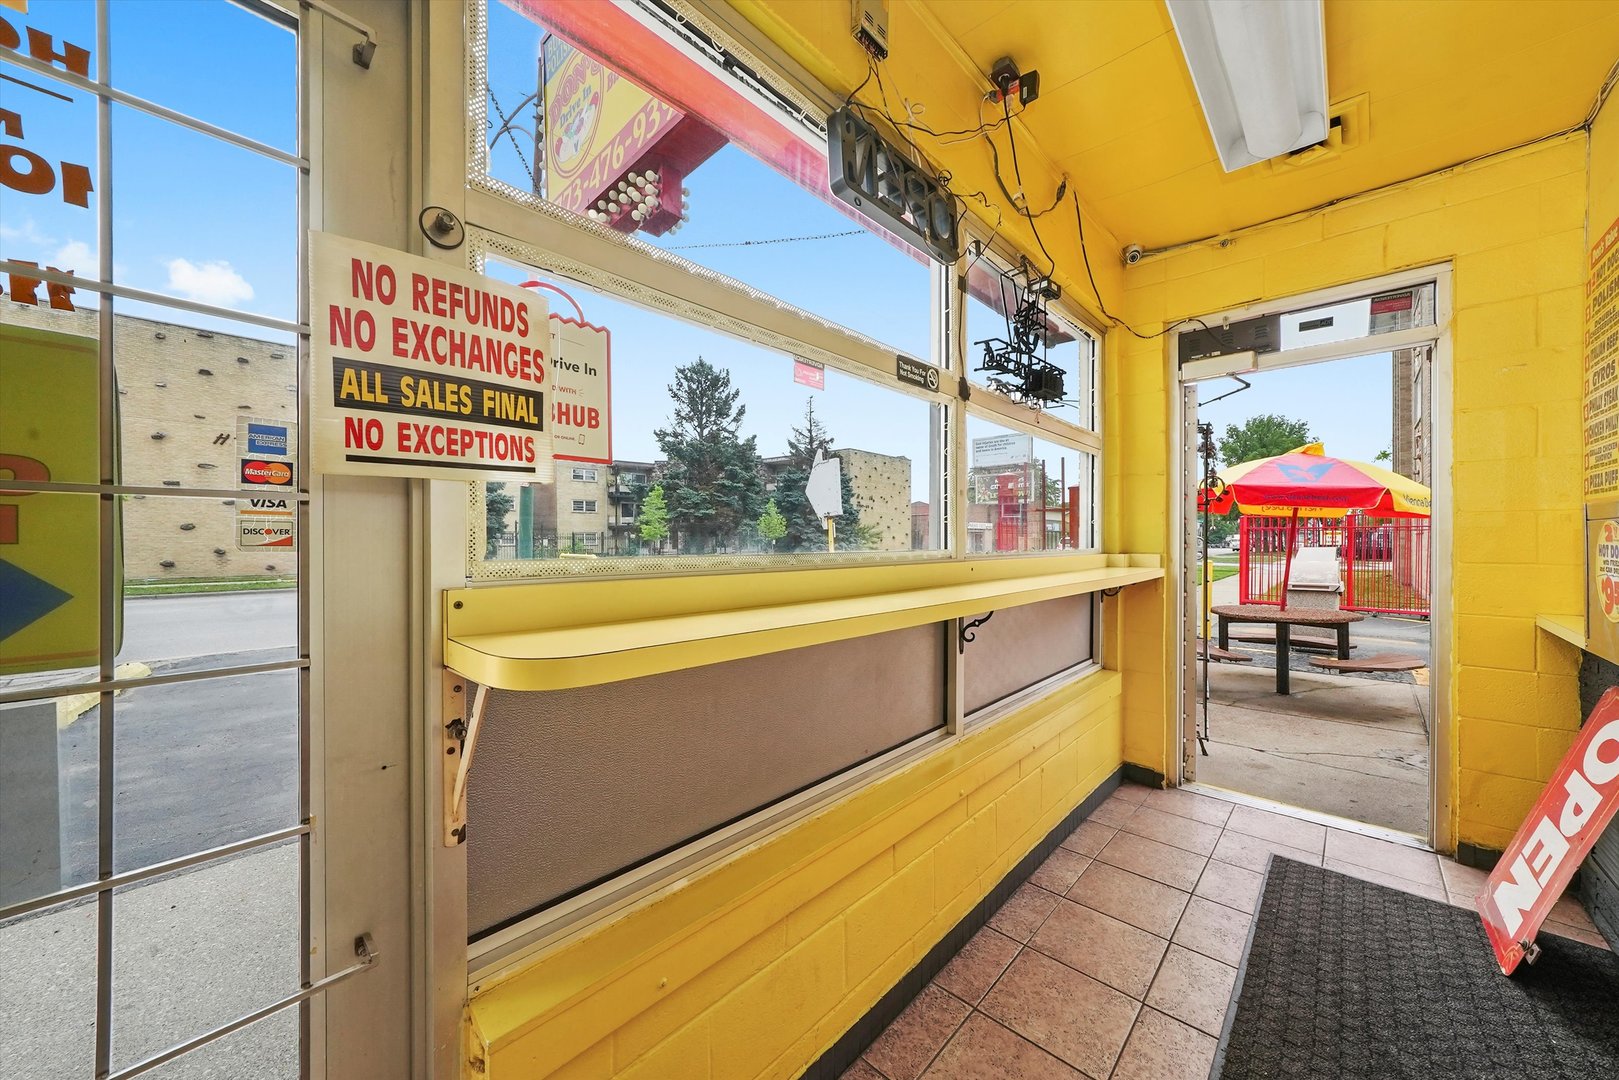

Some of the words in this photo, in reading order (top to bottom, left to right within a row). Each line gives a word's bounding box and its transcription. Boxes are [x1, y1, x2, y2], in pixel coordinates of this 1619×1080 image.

[560, 97, 581, 129] Drive
[352, 258, 396, 305] NO
[412, 273, 529, 338] REFUNDS
[329, 305, 375, 352] NO
[392, 317, 544, 383] EXCHANGES
[551, 358, 579, 373] rive
[585, 363, 597, 377] In
[899, 360, 911, 372] Thank
[1593, 358, 1616, 387] GYROS
[907, 371, 925, 384] Smoking
[340, 368, 388, 404] ALL
[400, 376, 472, 415] SALES
[483, 390, 538, 424] FINAL
[559, 386, 577, 395] WITH
[1603, 384, 1619, 408] STEAK
[248, 433, 286, 443] AMERICAN
[255, 440, 288, 448] EXPRESS
[345, 417, 383, 450] NO
[398, 422, 535, 463] EXCEPTIONS
[244, 468, 290, 478] MasterCard
[1589, 472, 1604, 490] PIZZA
[1604, 468, 1618, 486] PUFF
[250, 498, 287, 508] VISA
[243, 527, 291, 536] DISCOVER
[1599, 544, 1610, 558] HOT
[1493, 719, 1619, 939] OPEN
